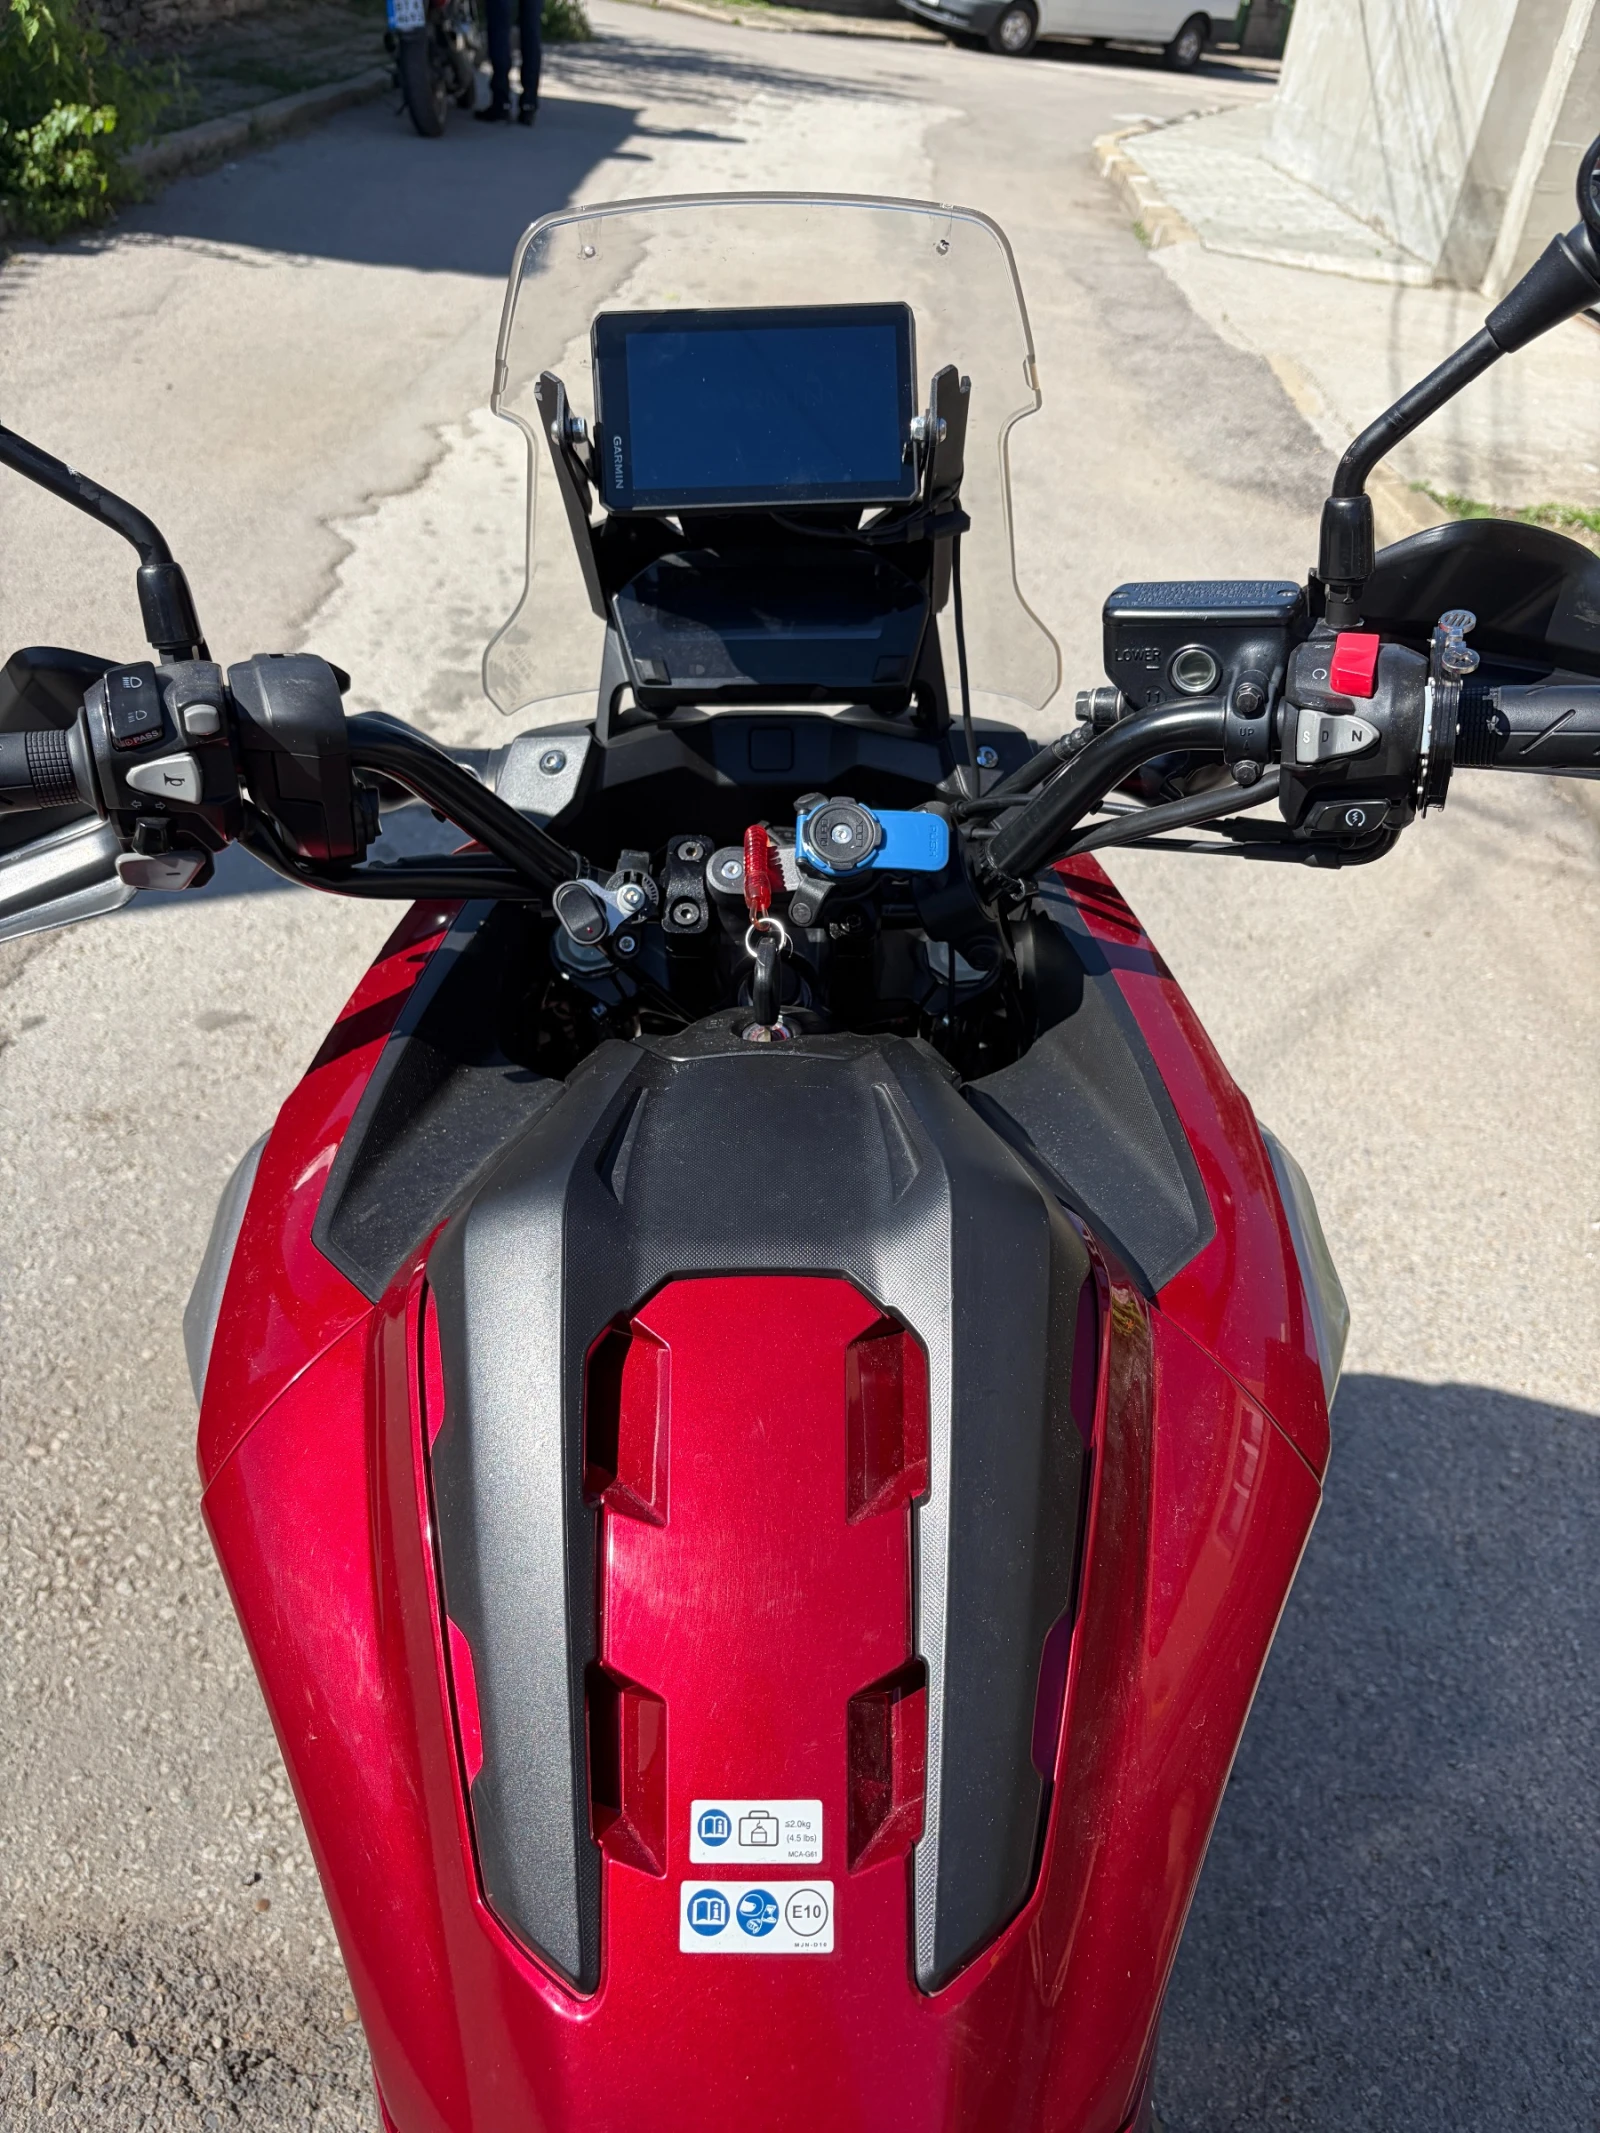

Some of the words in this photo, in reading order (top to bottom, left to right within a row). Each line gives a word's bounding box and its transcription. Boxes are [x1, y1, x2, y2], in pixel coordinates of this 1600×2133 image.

[613, 435, 624, 489] GARMIN
[1115, 648, 1162, 662] LOWER
[133, 730, 159, 744] PASS
[1239, 727, 1255, 737] UP
[1302, 730, 1311, 744] S
[1321, 730, 1330, 743] D
[1351, 730, 1363, 742] N
[855, 819, 864, 848] LOCK
[928, 824, 939, 858] PUSH
[786, 1833, 802, 1843] (4.5
[803, 1833, 817, 1843] lbs)
[792, 1905, 822, 1919] E10
